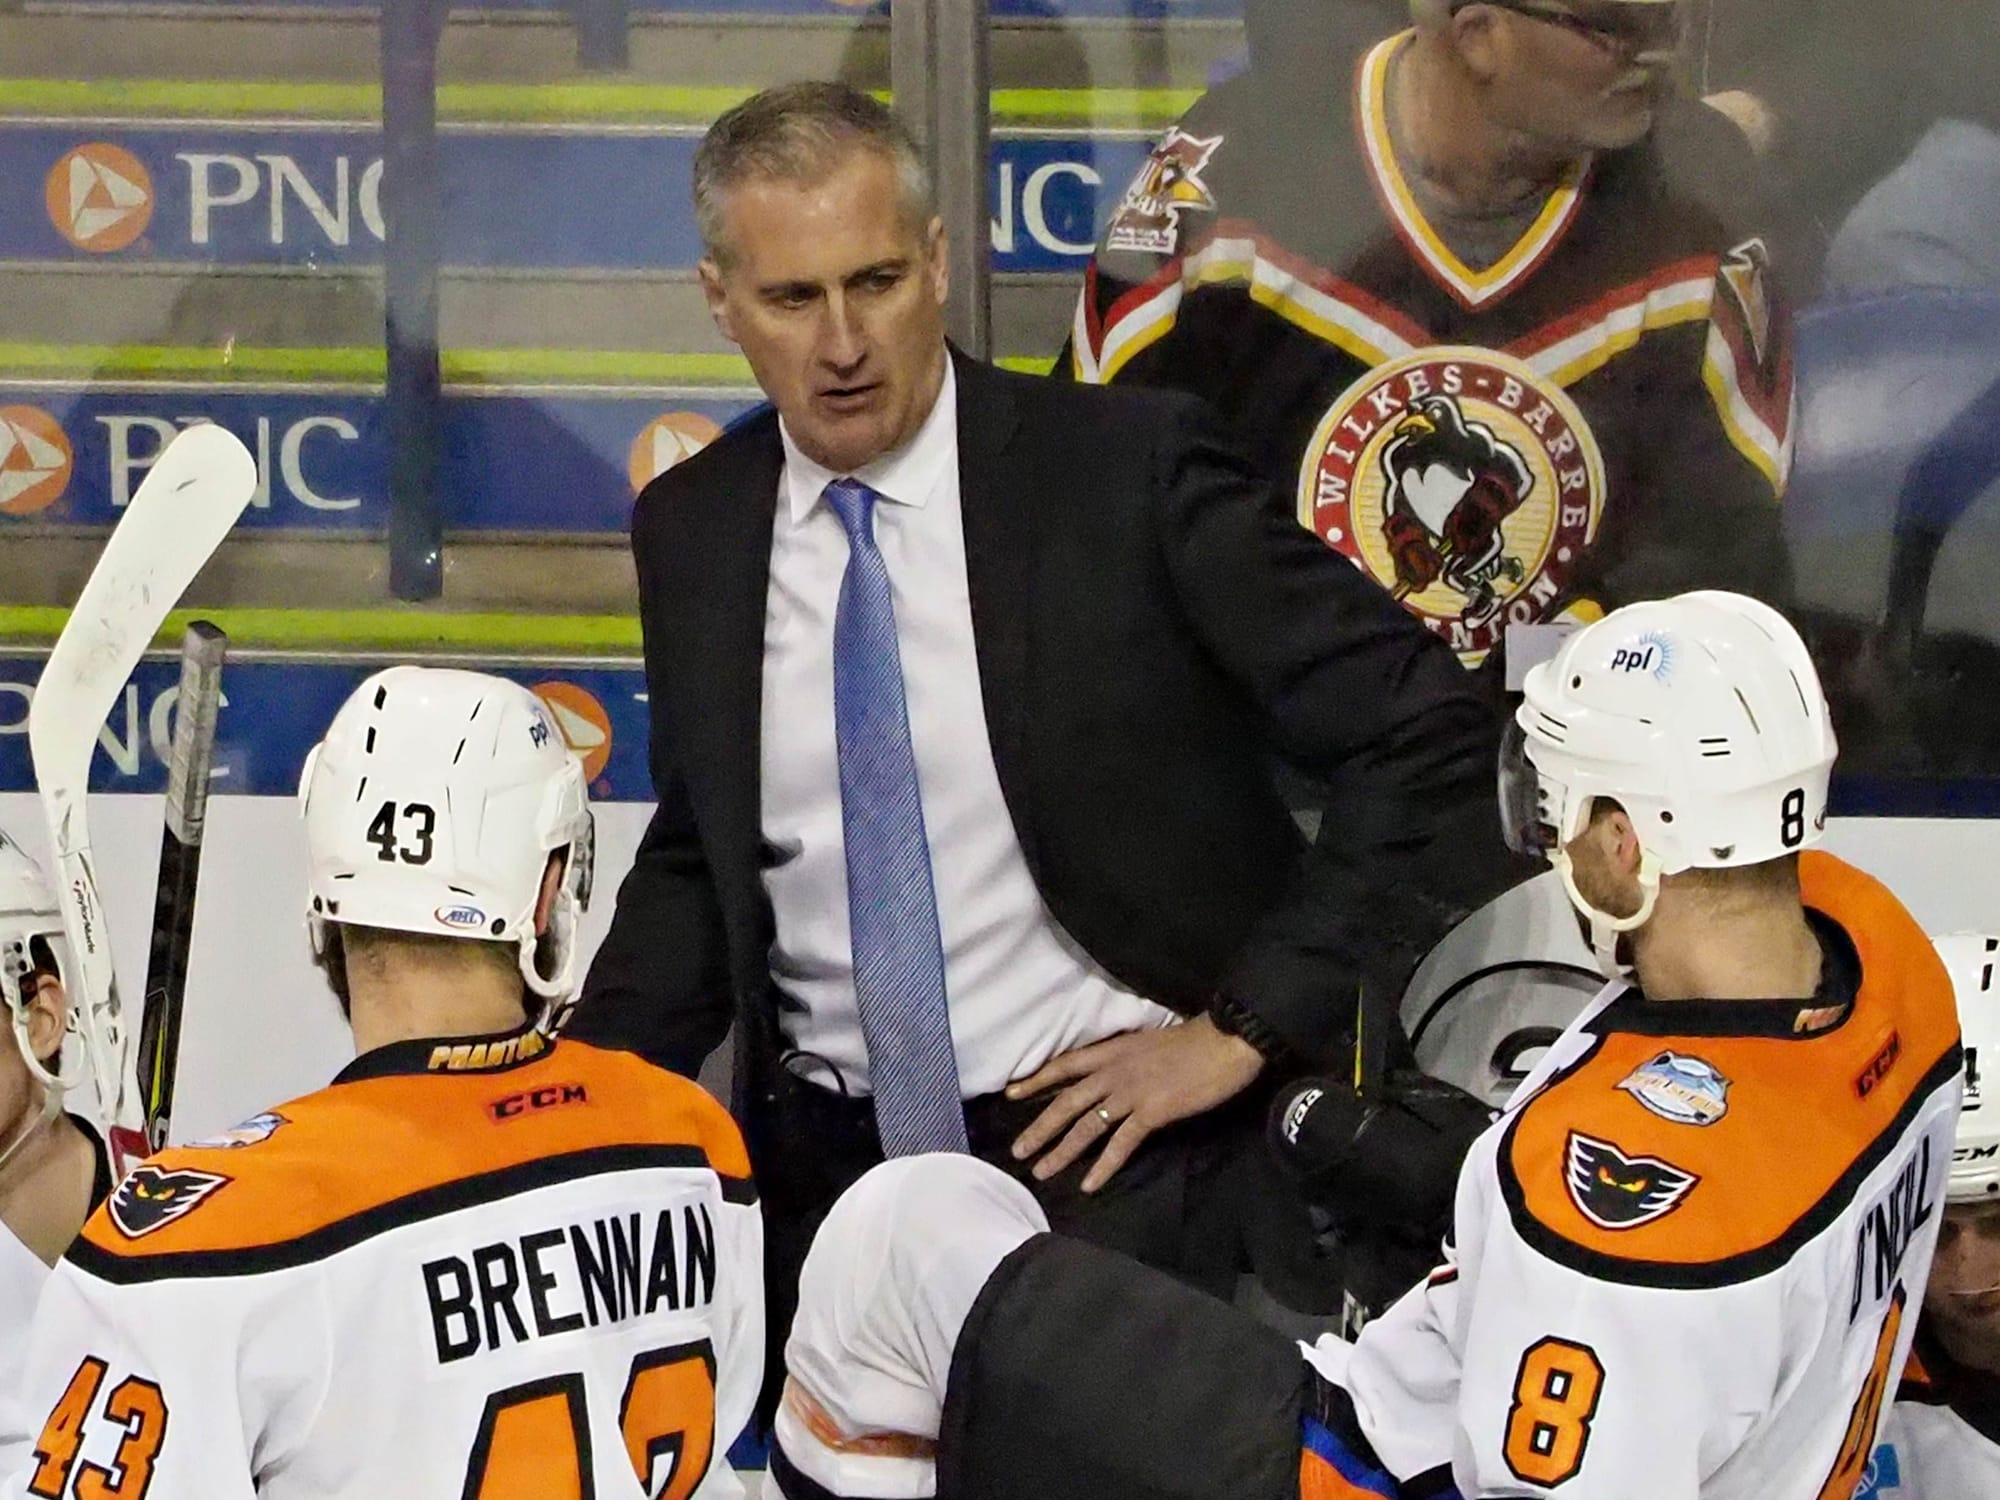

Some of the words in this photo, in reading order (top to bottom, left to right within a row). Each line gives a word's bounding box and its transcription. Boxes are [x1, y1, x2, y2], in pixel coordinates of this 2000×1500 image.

[1315, 364, 1588, 528] WILKES-BARRE
[1610, 646, 1654, 673] ppl
[366, 800, 436, 866] 43
[1780, 787, 1805, 848] 8
[494, 1085, 588, 1119] CCM
[421, 1202, 717, 1365] BRENNAN
[26, 1354, 169, 1500] 43
[1502, 1325, 1606, 1490] 8
